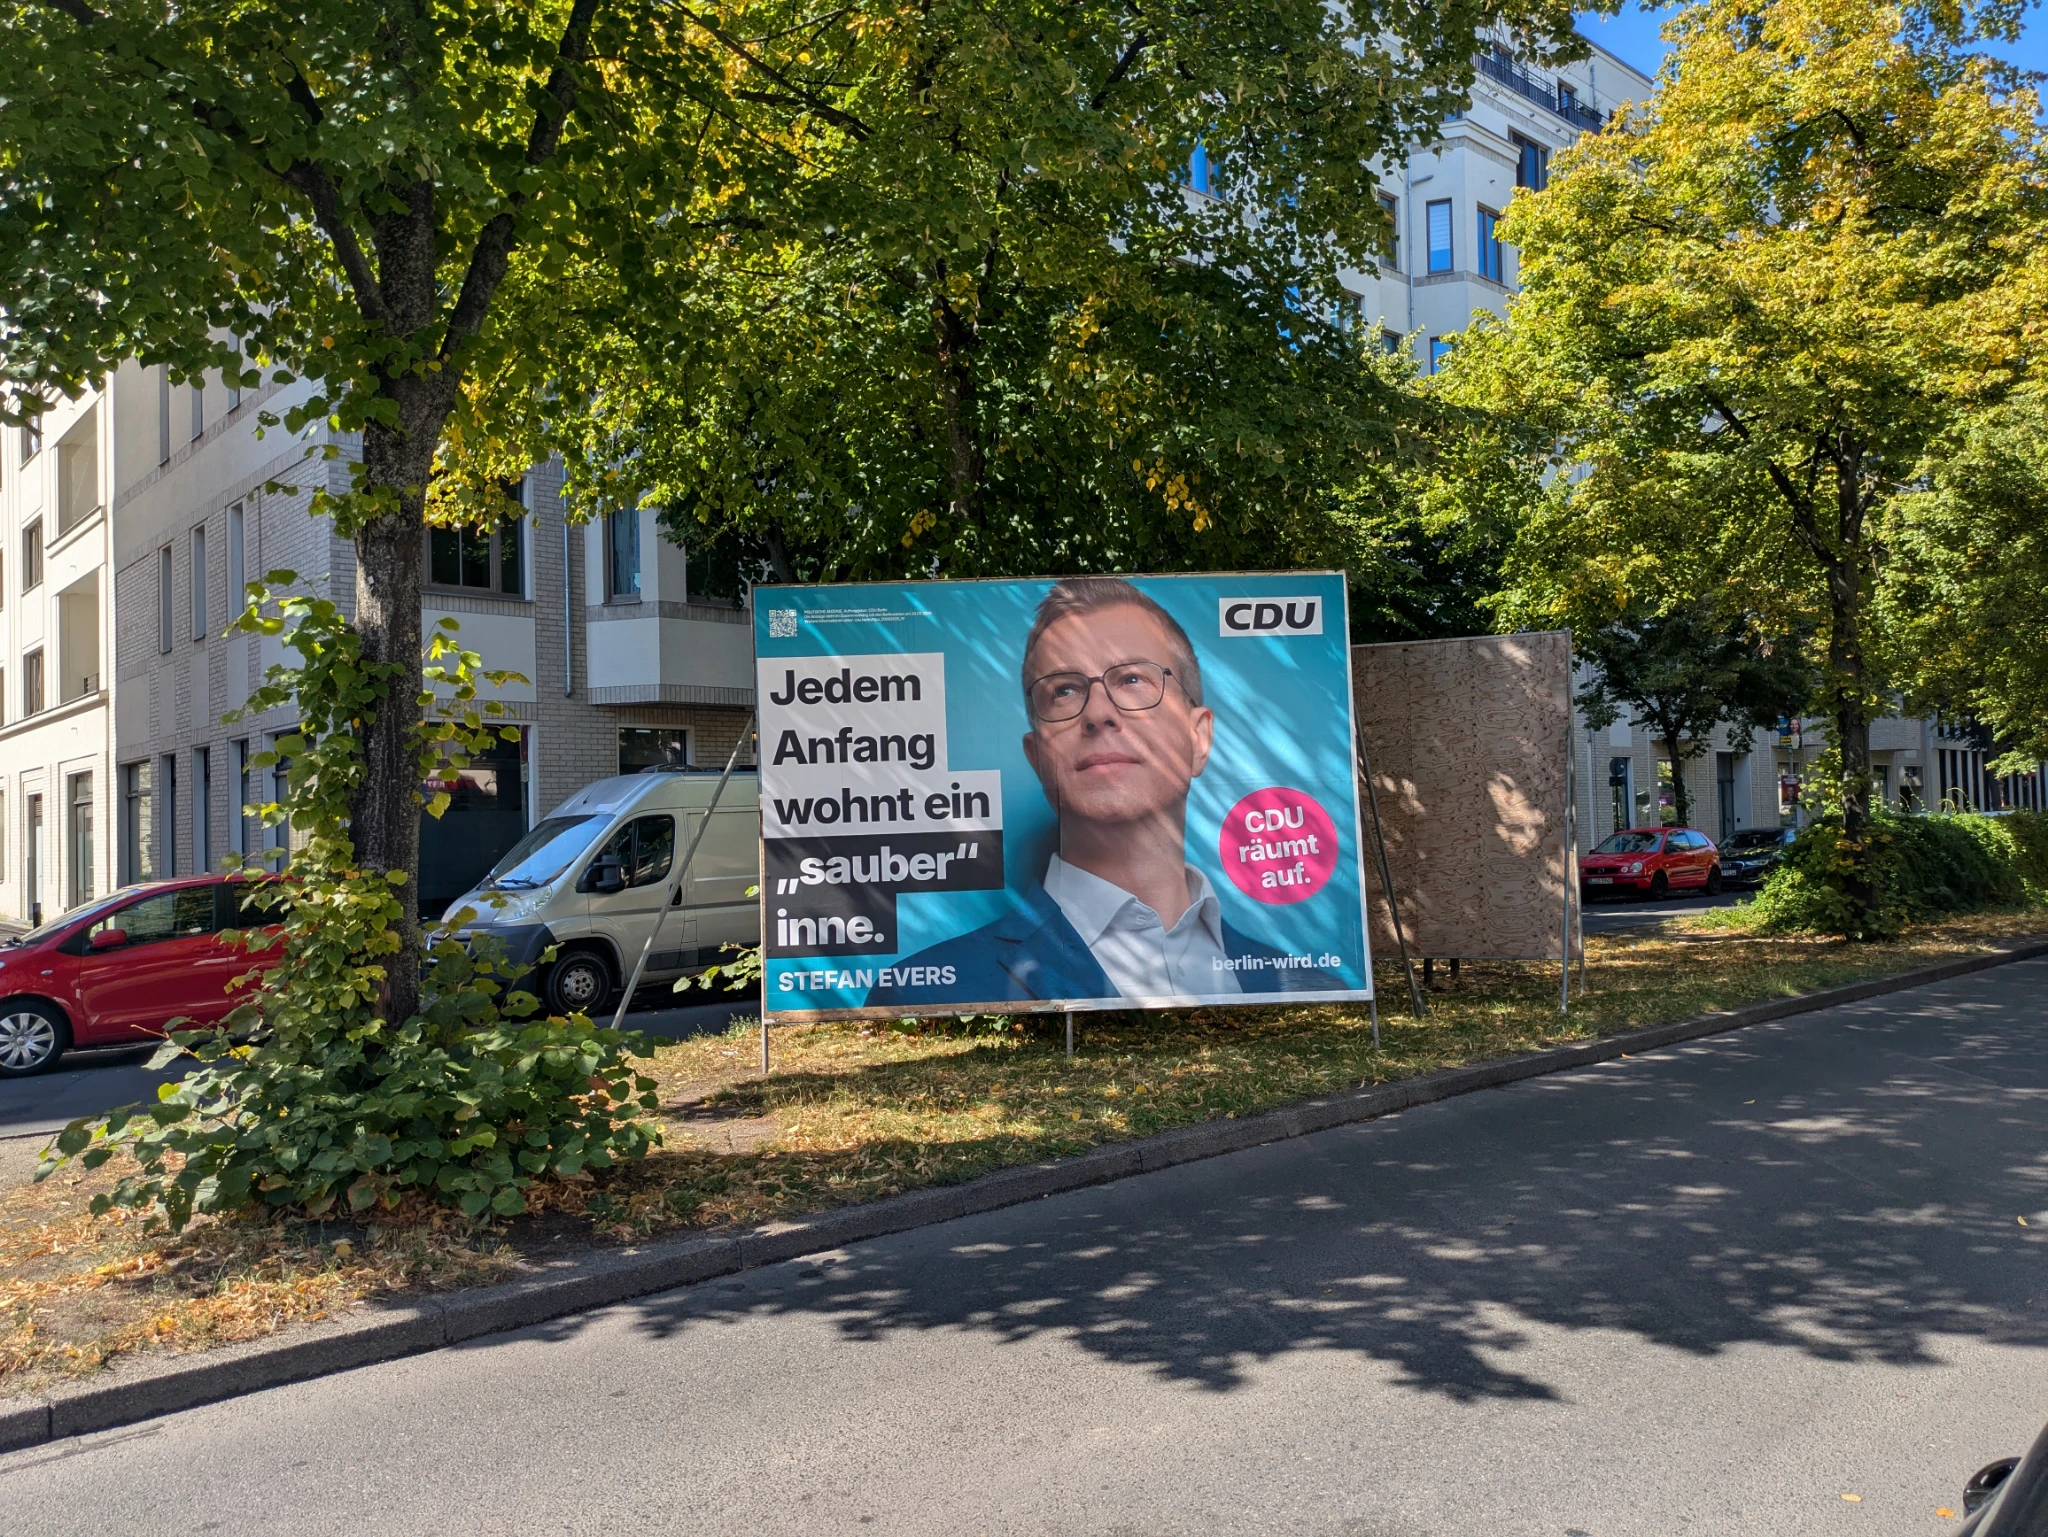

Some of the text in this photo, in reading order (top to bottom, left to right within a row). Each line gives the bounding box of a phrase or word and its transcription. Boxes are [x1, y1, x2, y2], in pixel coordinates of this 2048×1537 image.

[1225, 602, 1316, 631] CDU
[770, 668, 921, 706] Jedem
[772, 726, 935, 771] Anfang
[773, 781, 990, 826] wohnt ein
[1244, 805, 1305, 833] CDU
[1238, 834, 1320, 863] räumt
[1261, 861, 1311, 889] auf.
[777, 908, 885, 947] inne.
[1212, 952, 1342, 971] berlin-wird.de
[778, 965, 957, 992] STEFAN EVERS
